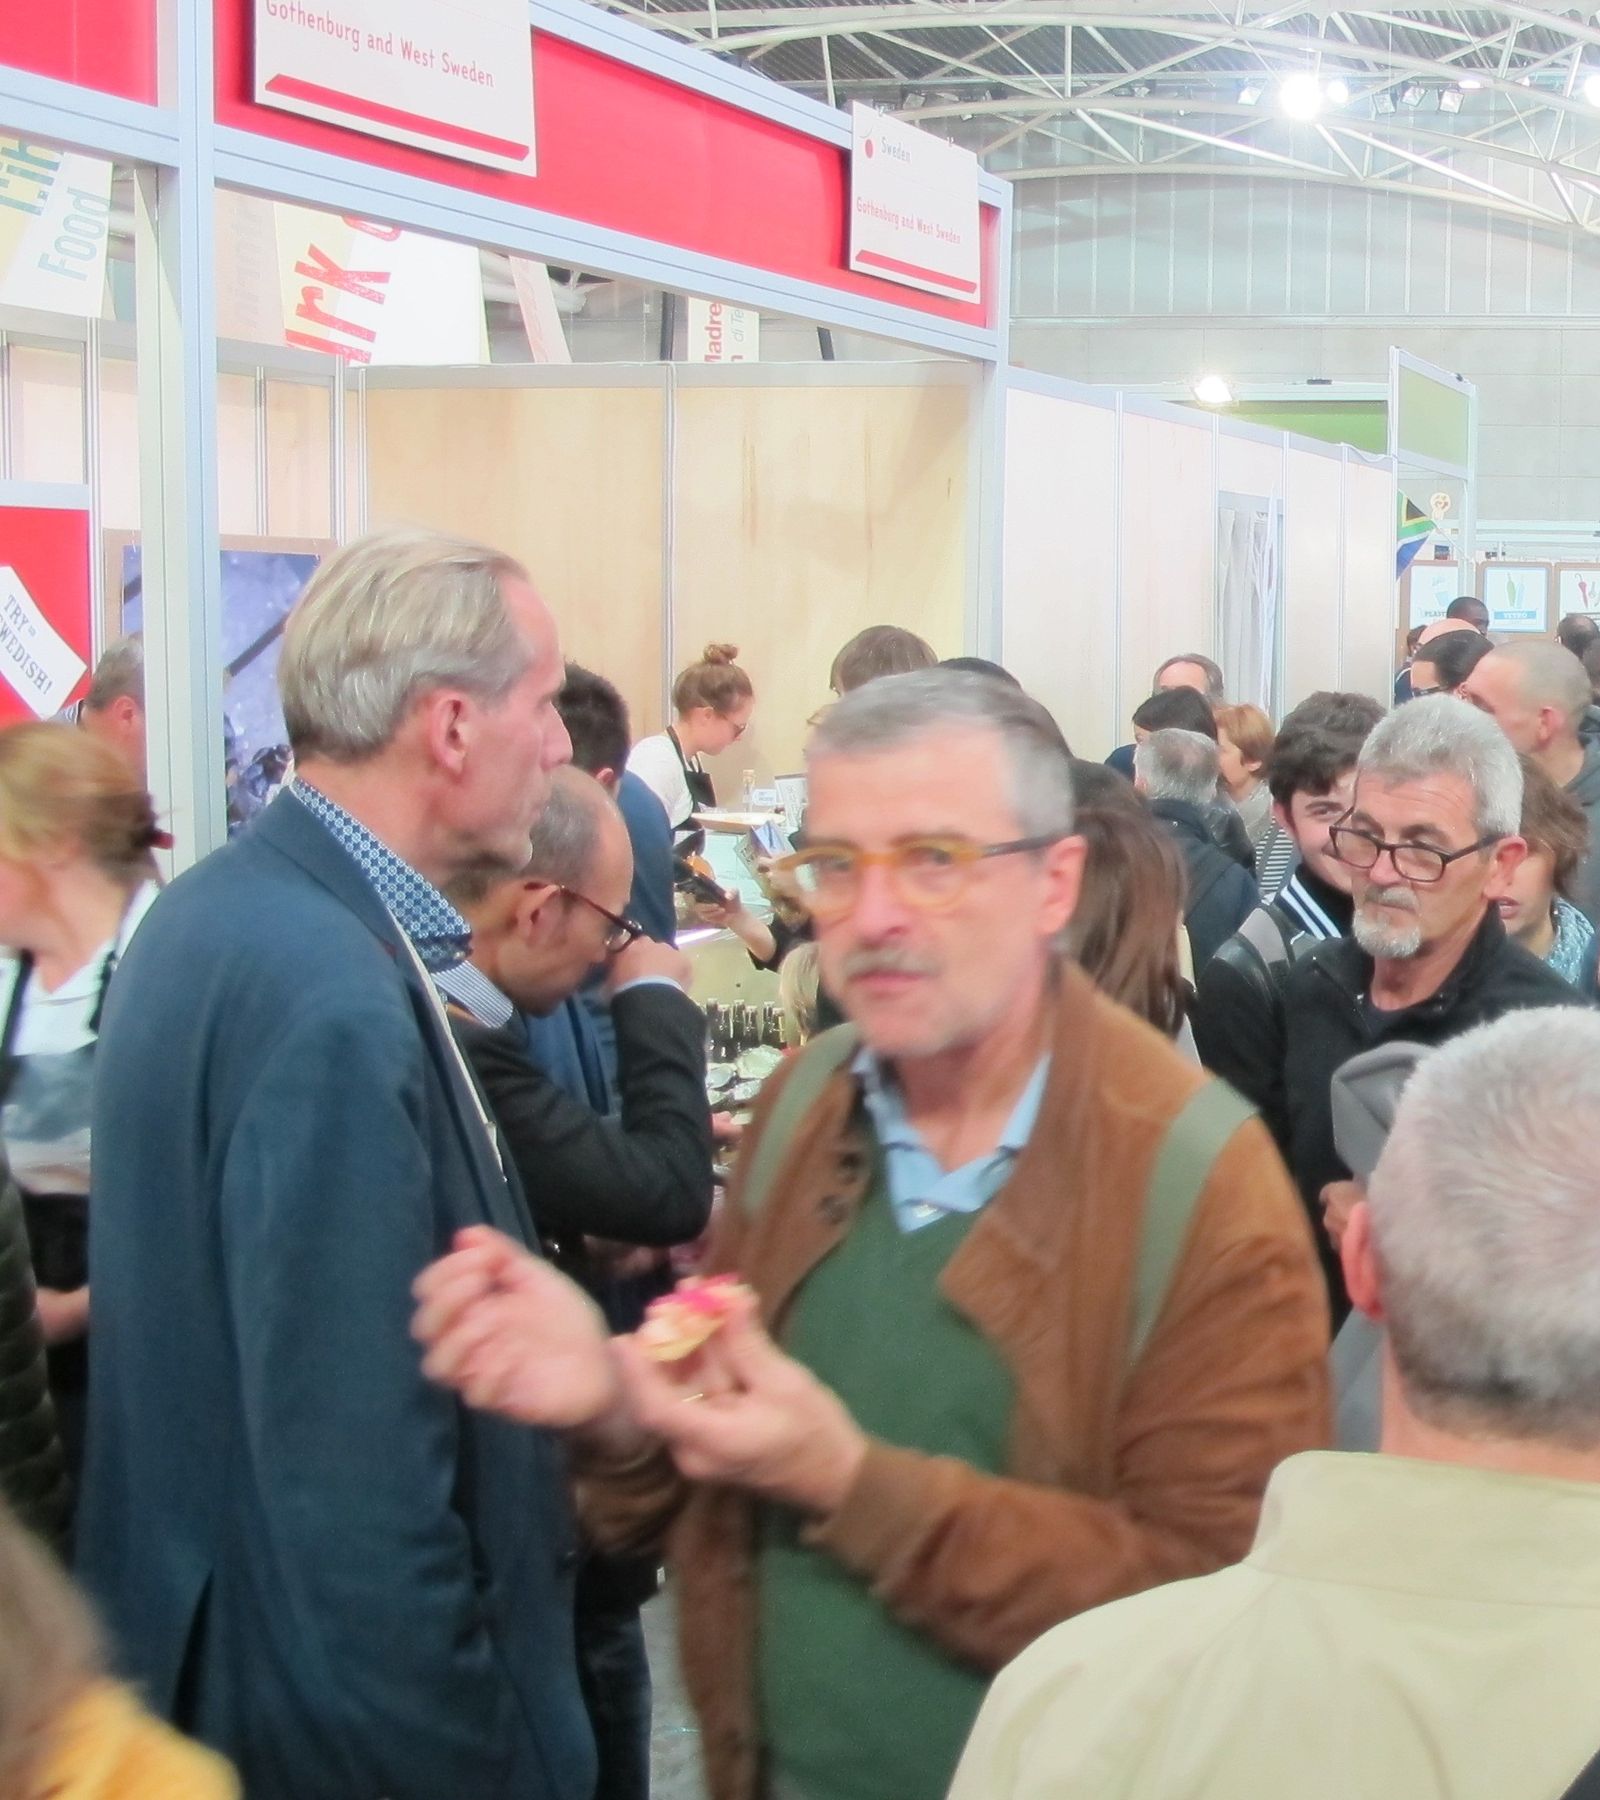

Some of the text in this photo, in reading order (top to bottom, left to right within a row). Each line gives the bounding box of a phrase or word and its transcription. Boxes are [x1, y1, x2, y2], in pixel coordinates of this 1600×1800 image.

[266, 0, 495, 88] Gothenburg and West Sweden
[881, 136, 911, 162] Sweden
[37, 187, 110, 281] Food
[857, 197, 961, 244] Gothenburg and West Sweden
[4, 594, 30, 632] TRY
